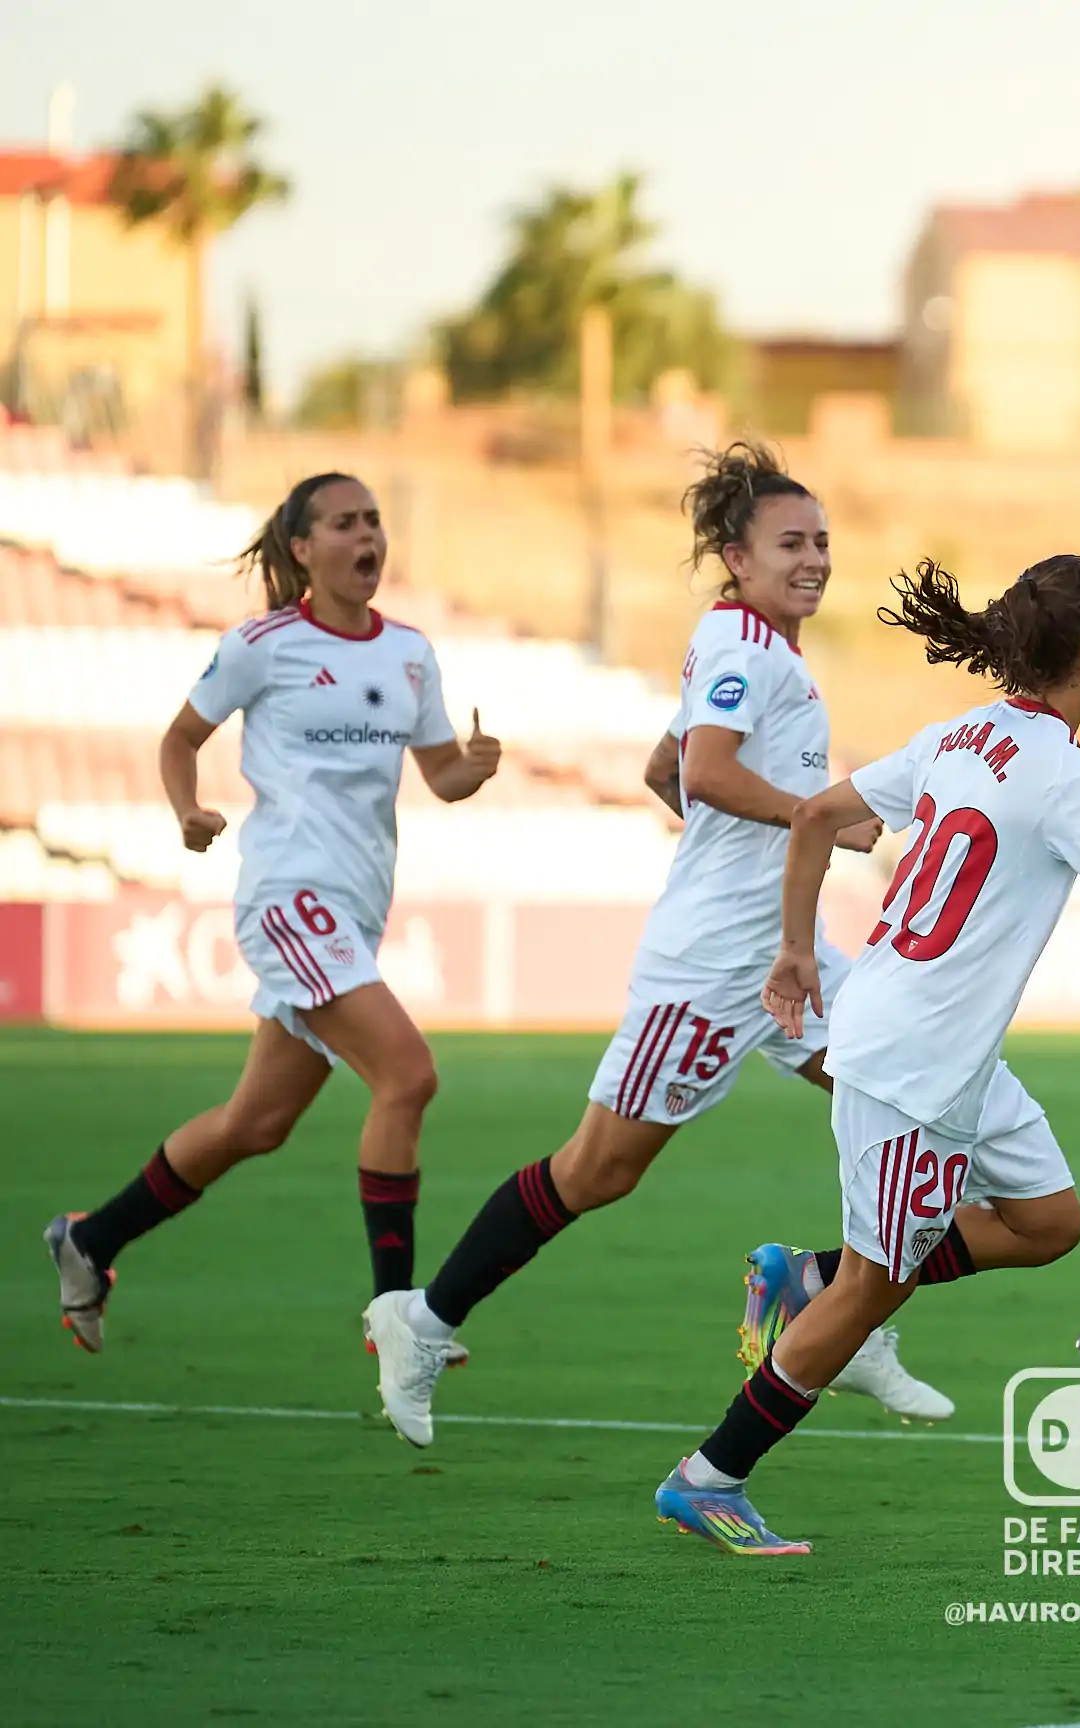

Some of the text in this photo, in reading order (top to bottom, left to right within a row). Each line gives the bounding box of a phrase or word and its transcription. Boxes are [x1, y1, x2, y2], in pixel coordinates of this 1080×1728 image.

[983, 735, 1020, 783] M.
[866, 791, 1000, 962] 20
[293, 889, 338, 936] 6
[676, 1015, 735, 1081] 15
[910, 1149, 969, 1219] 20
